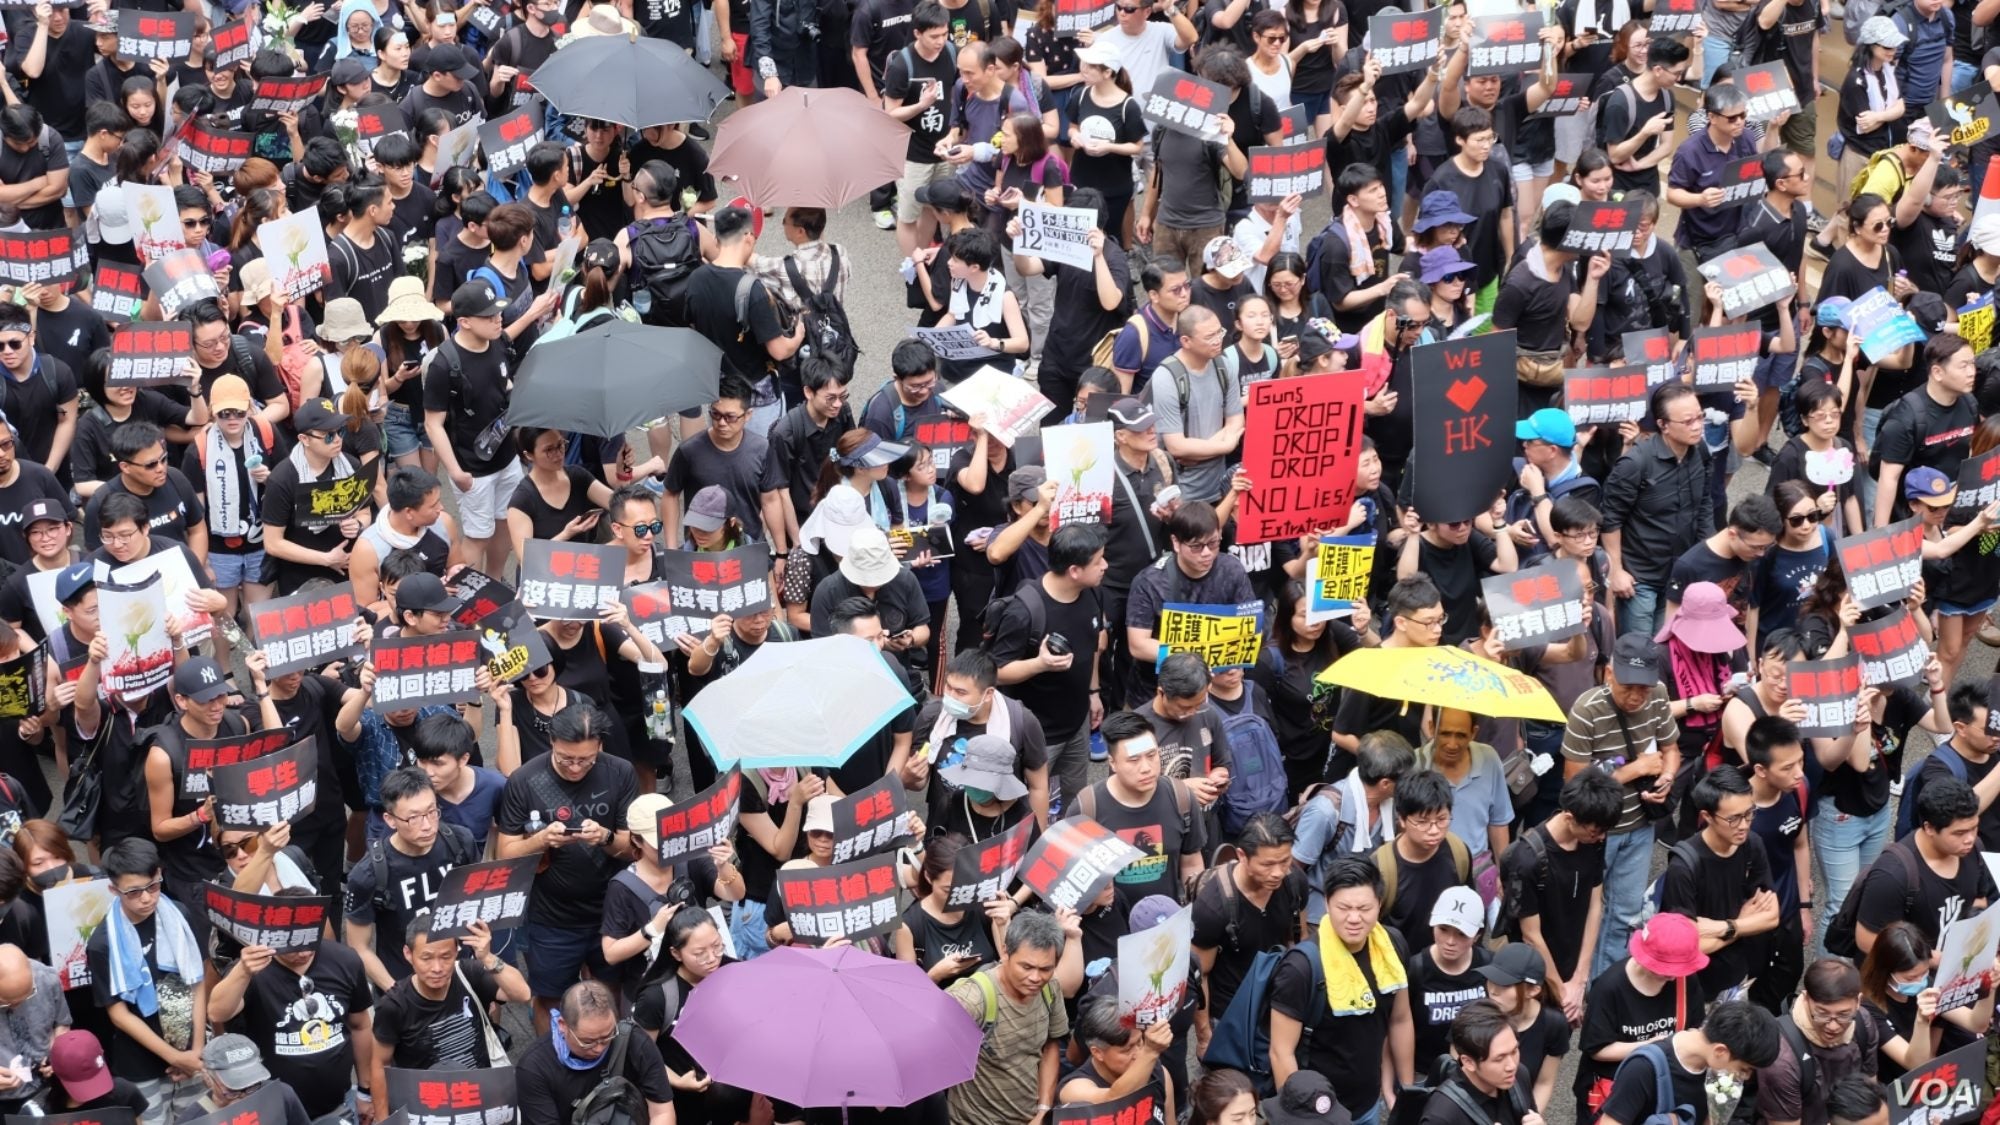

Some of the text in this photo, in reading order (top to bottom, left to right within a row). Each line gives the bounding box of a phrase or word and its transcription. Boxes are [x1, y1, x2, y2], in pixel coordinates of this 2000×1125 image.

[1022, 208, 1036, 229] 6
[1020, 227, 1042, 251] 12
[1444, 350, 1483, 370] WE
[1275, 402, 1342, 430] DROP
[1273, 428, 1339, 457] DROP
[1445, 414, 1493, 455] HK
[1271, 454, 1335, 479] DROP
[1246, 487, 1288, 516] NO
[1955, 480, 2000, 508] 沒有
[550, 551, 602, 579] 學生
[690, 558, 740, 584] 學生
[522, 579, 621, 612] 沒有暴動
[668, 578, 767, 612] 沒有暴動
[255, 593, 356, 638] 問責槍擊
[1166, 611, 1255, 645] 保護下一代
[262, 625, 357, 669] 撤回控罪
[374, 641, 477, 674] 問責槍擊
[105, 675, 124, 690] NO
[375, 667, 478, 703] 撤回控罪
[247, 760, 298, 797] 學生
[222, 780, 316, 826] 沒有暴動
[853, 789, 897, 828] 學生
[662, 796, 740, 859] 撤回控
[463, 866, 511, 895] 學生
[784, 867, 895, 907] 問責槍擊
[431, 891, 527, 932] 沒有暴動
[790, 897, 898, 938] 撤回控罪
[1424, 987, 1486, 1006] NOTHING
[418, 1081, 482, 1109] 學生
